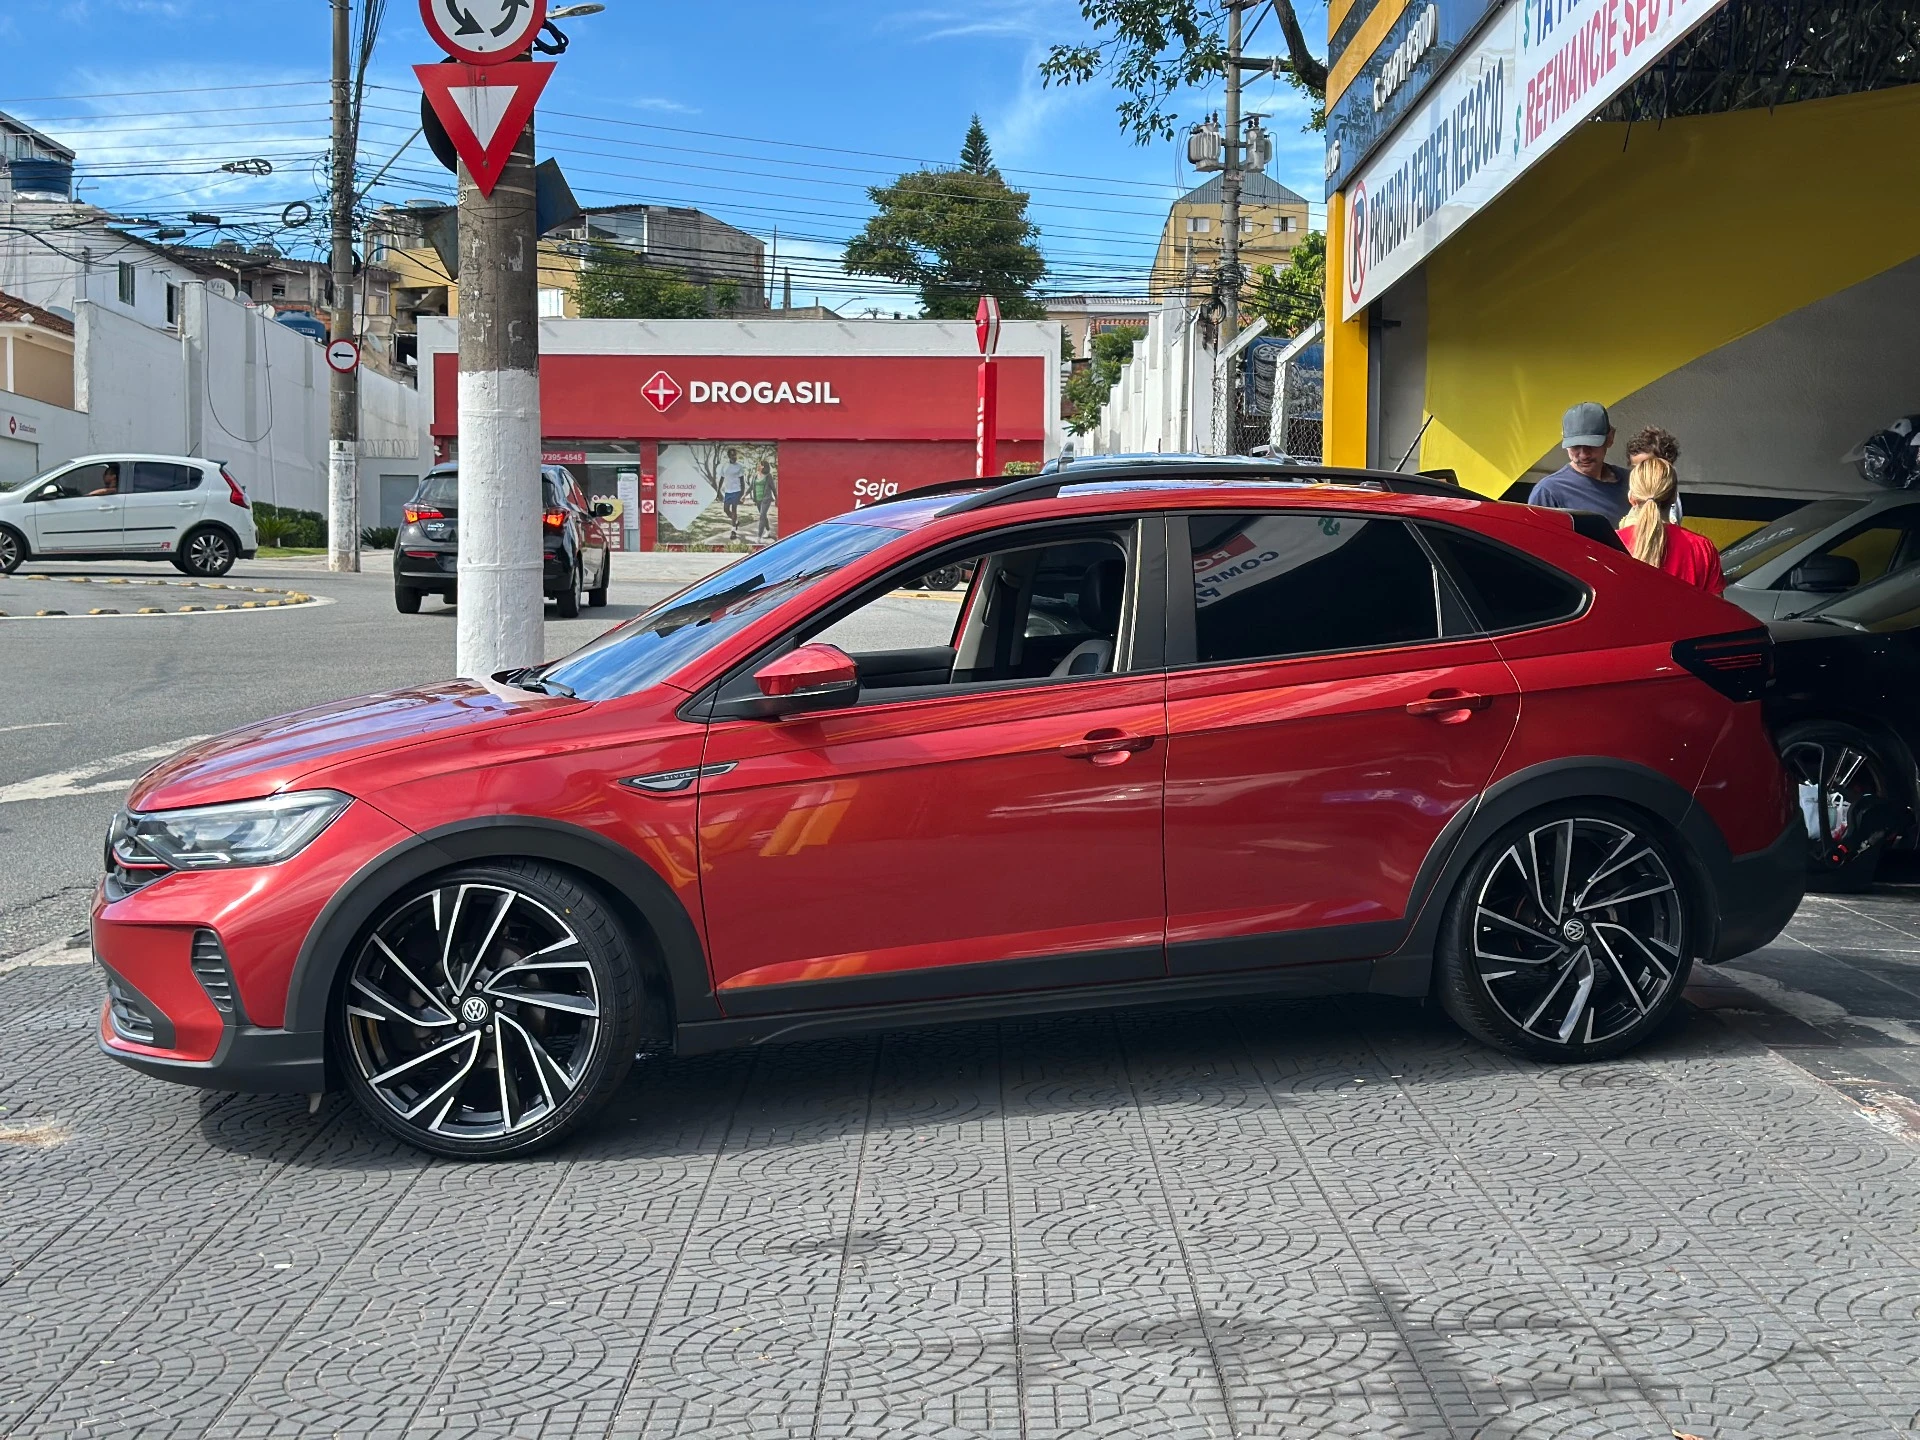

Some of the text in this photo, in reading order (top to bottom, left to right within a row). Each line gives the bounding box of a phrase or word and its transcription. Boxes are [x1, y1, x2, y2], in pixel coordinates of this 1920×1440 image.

[1525, 0, 1618, 148] REFINANCIE
[1369, 56, 1504, 271] PROIBIDO PERDER NEGÓCIO
[690, 381, 840, 404] DROGASIL
[853, 478, 899, 501] Seja
[664, 772, 691, 780] NIVUS
